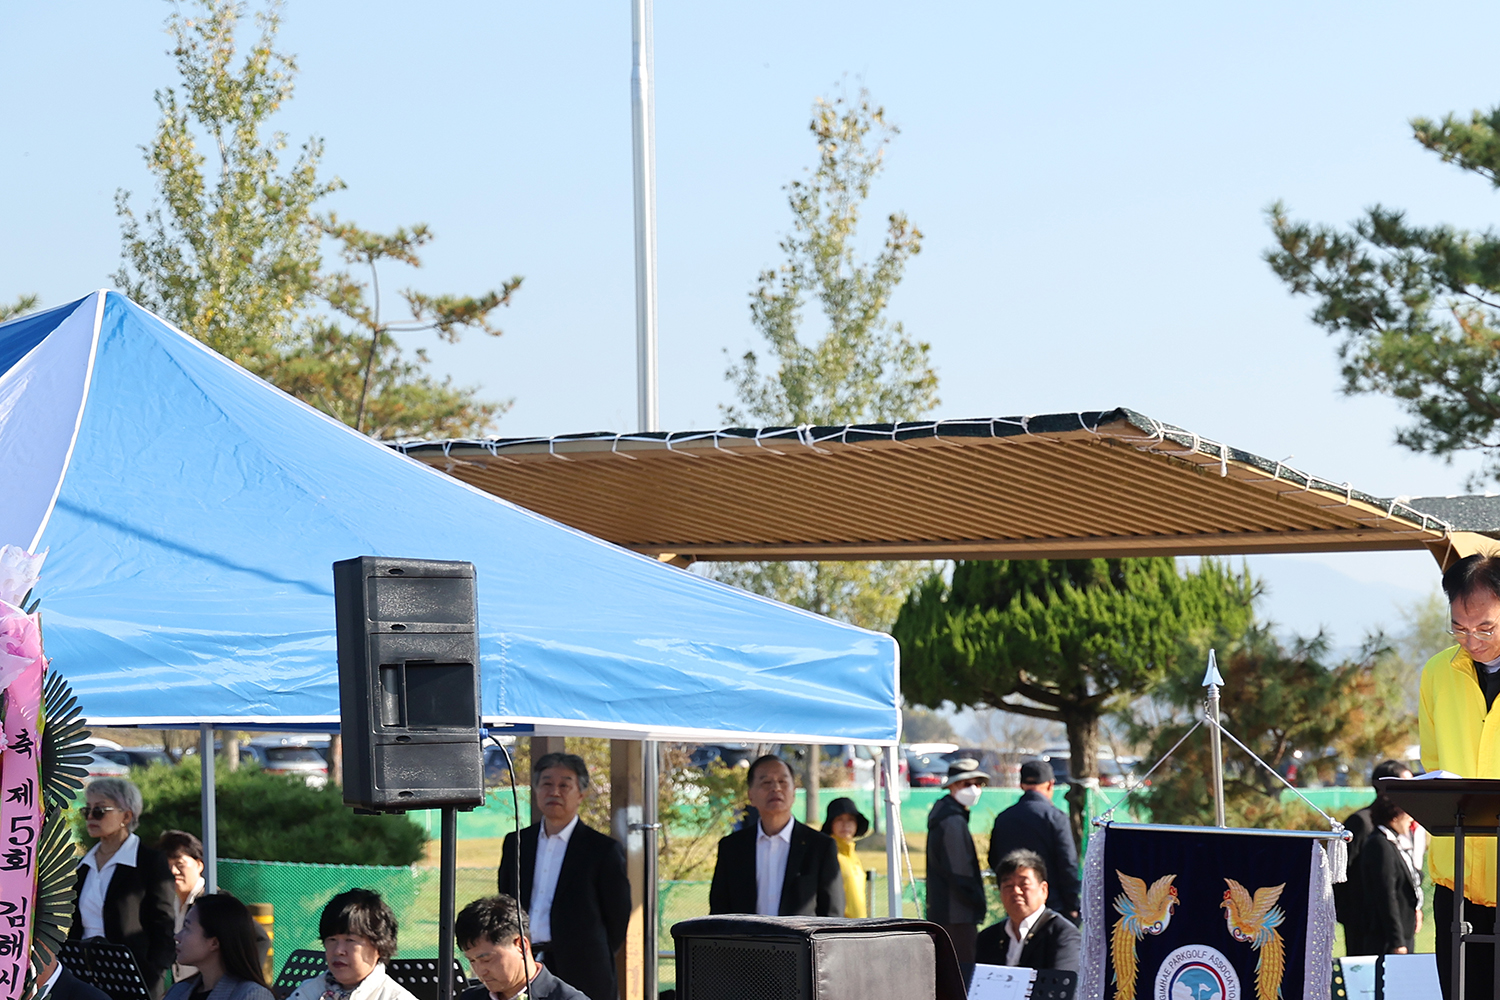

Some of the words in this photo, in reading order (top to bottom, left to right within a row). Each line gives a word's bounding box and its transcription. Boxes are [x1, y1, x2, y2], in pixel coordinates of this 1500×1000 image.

[7, 728, 34, 759] 축
[0, 778, 34, 878] 제5회
[1158, 968, 1172, 1000] GIMHAE
[1168, 949, 1208, 969] PARKGOLF
